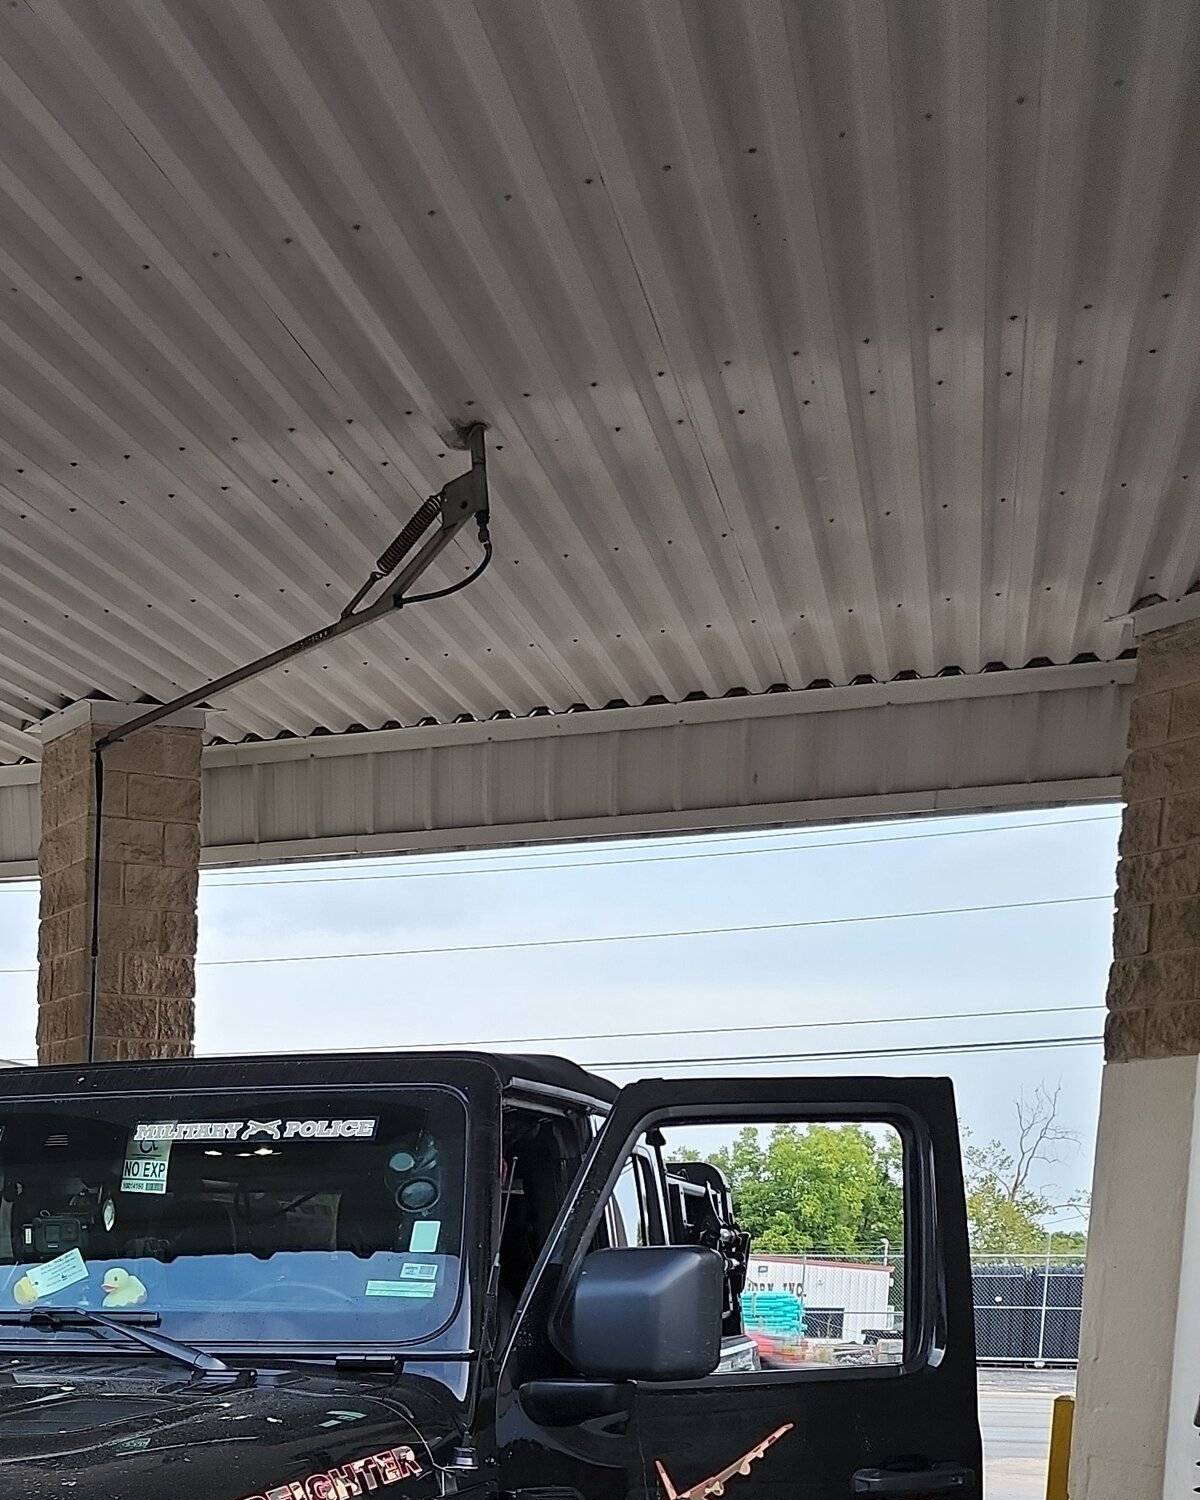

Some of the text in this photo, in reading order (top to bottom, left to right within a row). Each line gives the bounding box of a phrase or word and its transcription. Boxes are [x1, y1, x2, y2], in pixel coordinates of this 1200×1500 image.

[133, 1119, 375, 1141] MILITARY POLICE
[123, 1161, 166, 1178] NO EXP
